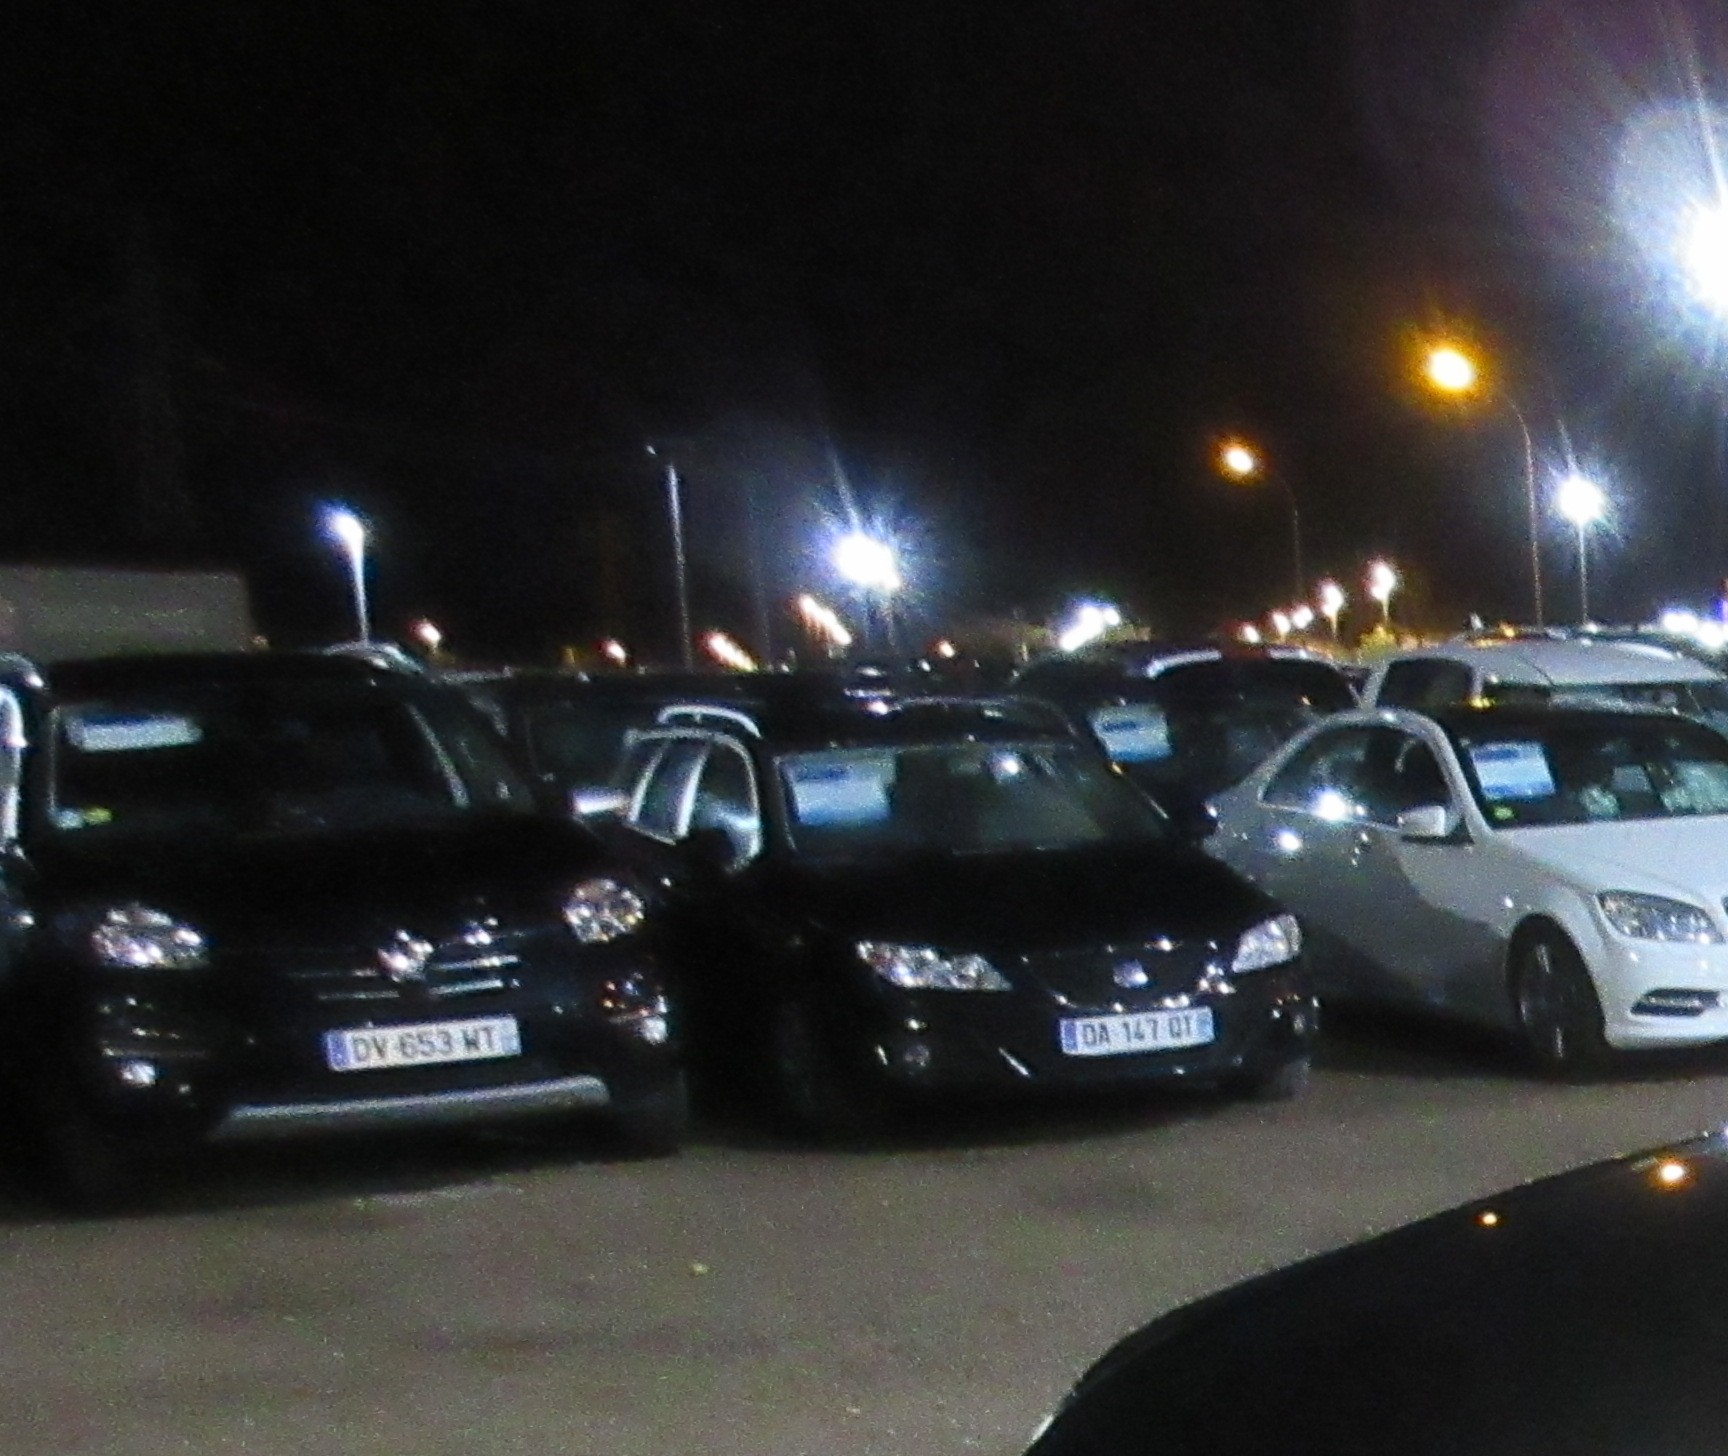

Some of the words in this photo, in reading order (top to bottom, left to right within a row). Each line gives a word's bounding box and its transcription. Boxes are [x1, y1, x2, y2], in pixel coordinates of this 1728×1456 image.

[353, 1033, 388, 1062] DV
[401, 1028, 450, 1057] 653
[1083, 1022, 1110, 1045] DA
[1123, 1017, 1158, 1042] 147
